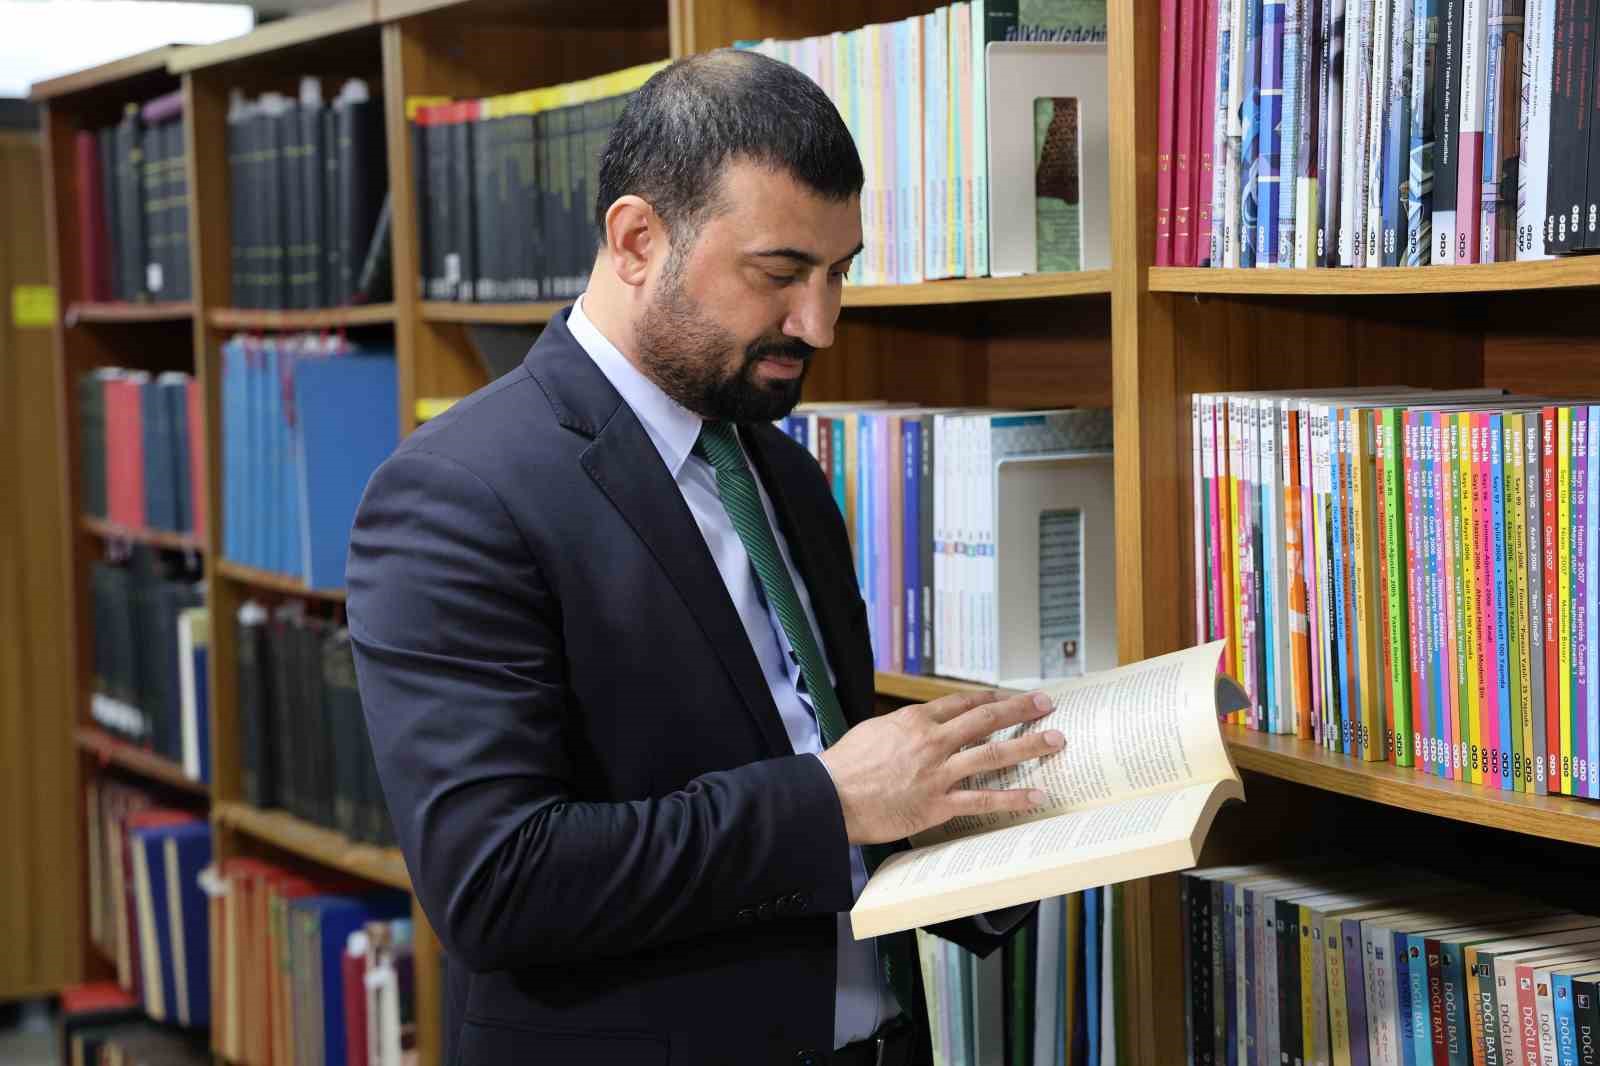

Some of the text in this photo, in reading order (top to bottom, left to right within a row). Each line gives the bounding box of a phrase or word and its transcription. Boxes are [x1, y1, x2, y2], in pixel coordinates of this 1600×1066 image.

[1526, 427, 1537, 464] kitap-lık
[1576, 420, 1586, 456] kitap-lık
[1492, 475, 1500, 491] Sayı
[1514, 477, 1522, 494] Sayı
[1527, 474, 1536, 492] Sayı
[1577, 469, 1586, 487] Sayı
[1493, 493, 1500, 503] 97
[1515, 496, 1522, 505] 99
[1473, 519, 1481, 549] Haziran
[1494, 521, 1502, 540] Eylül
[1529, 526, 1538, 550] Aralık
[1543, 419, 1555, 641] kitap-lık Sayı 101 Ocak 2007 Yaşar Kemal
[1560, 526, 1568, 550] Nisan
[1578, 525, 1586, 557] Haziran
[1517, 551, 1525, 569] 2006
[1530, 551, 1538, 571] 2006
[1560, 555, 1568, 576] 2007
[1578, 561, 1586, 583] 2007
[1475, 588, 1483, 614] Ahmet
[1497, 610, 1505, 640] Beckett
[1532, 615, 1541, 646] Kimdir?
[1577, 606, 1586, 641] Eleştiride
[1497, 658, 1507, 688] Yaşında
[1410, 973, 1425, 1038] DOĞU BATI
[1430, 977, 1444, 1044] DOĞU BATI
[1443, 982, 1459, 1053] DOĞU BATI
[1482, 992, 1497, 1065] DOĞU BATI
[1500, 1003, 1512, 1044] DOĞU
[1522, 1006, 1536, 1047] DOĞU
[1540, 1013, 1552, 1051] DOĞU
[1559, 1016, 1574, 1055] DOĞU
[1580, 1025, 1596, 1064] DOĞU
